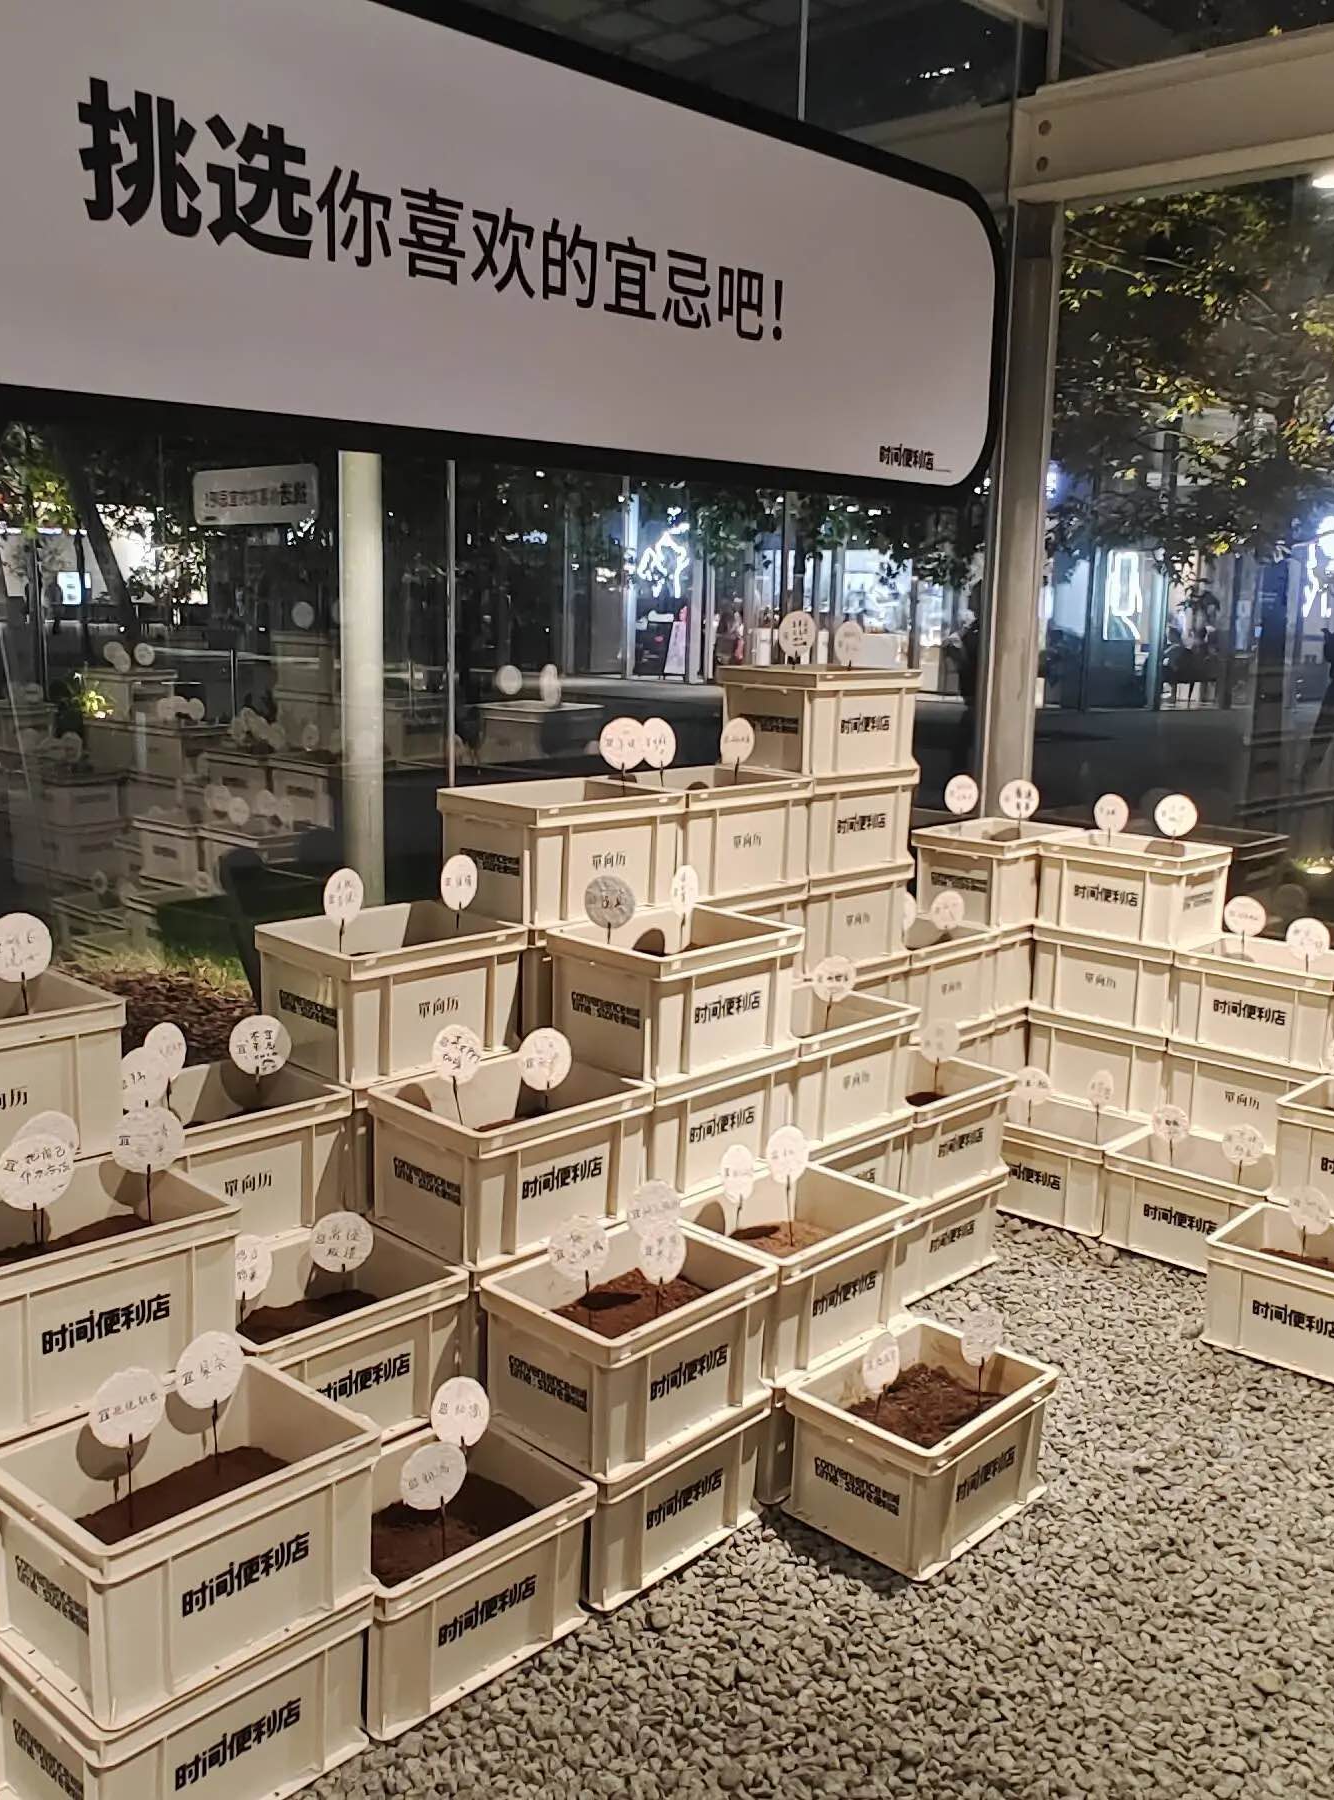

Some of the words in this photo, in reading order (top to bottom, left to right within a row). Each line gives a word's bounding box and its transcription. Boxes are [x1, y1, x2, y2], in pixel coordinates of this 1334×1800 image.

[76, 76, 786, 343] 挑选你喜欢的宜忌吧!
[1074, 883, 1140, 907] 时间便利店
[695, 991, 760, 1024] 时间便利店
[1214, 1000, 1286, 1025] 时间便利店
[690, 1105, 754, 1143] 时间便利店
[521, 1157, 602, 1199] 时间便利店
[1006, 1162, 1061, 1190] 间便利店
[41, 1293, 170, 1354] 时间便利店
[650, 1340, 732, 1401] 时间便利店
[646, 1468, 729, 1530] 时间便利店
[956, 1445, 1016, 1507] 时间便利店
[182, 1531, 309, 1617] 时间便利店
[435, 1573, 537, 1647] 时间便利店
[175, 1697, 303, 1792] 时间便利店
